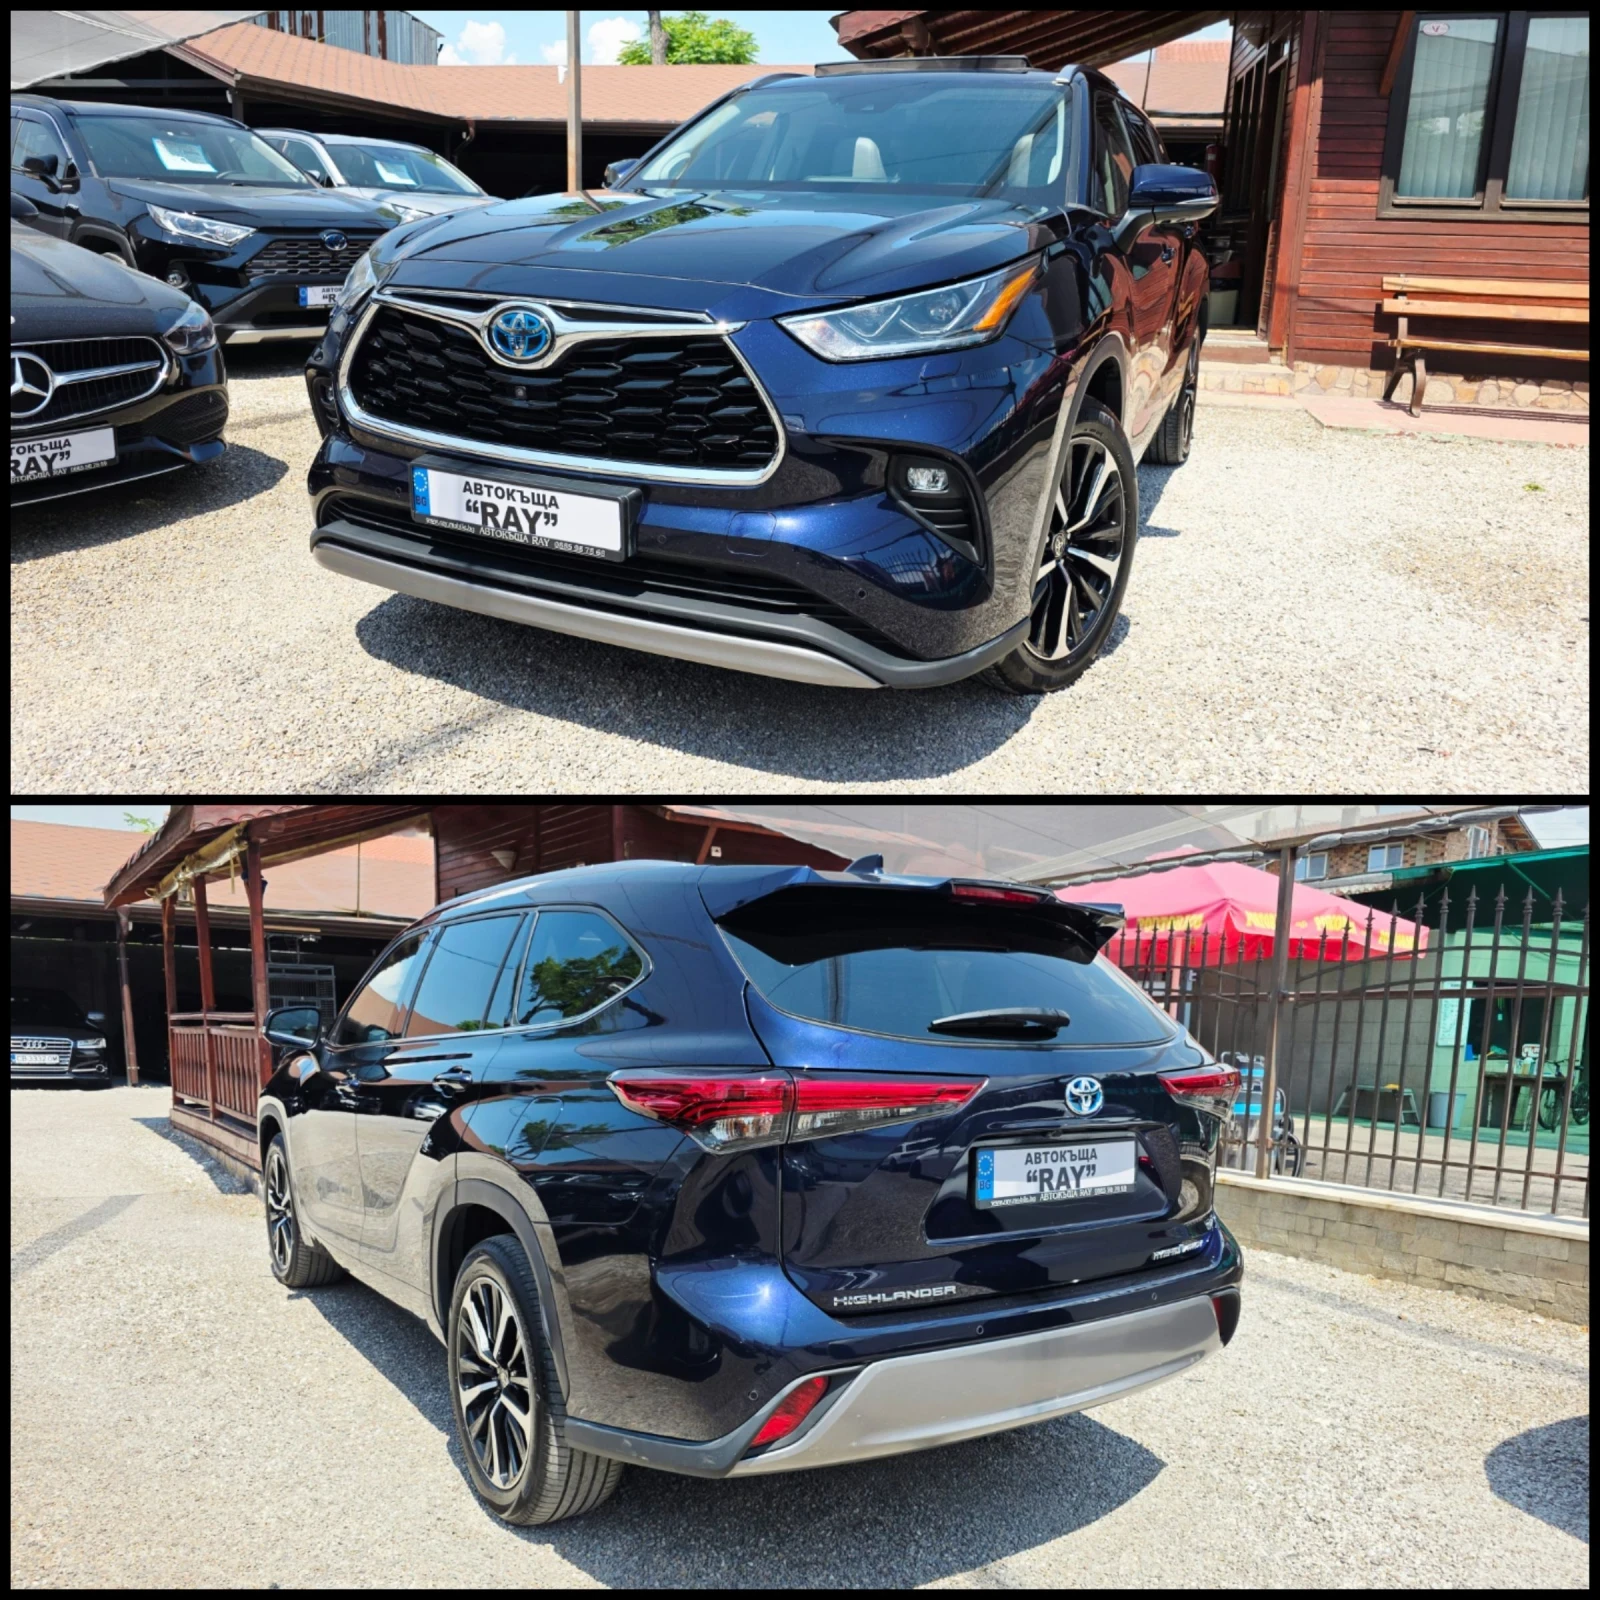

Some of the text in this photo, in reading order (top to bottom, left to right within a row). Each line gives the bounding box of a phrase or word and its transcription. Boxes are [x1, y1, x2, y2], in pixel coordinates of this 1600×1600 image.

[414, 495, 427, 506] BG
[462, 481, 560, 510] АВТОКЪЩА
[465, 499, 559, 535] “RAY”
[479, 526, 529, 544] АВТОКЪЩА
[531, 535, 550, 547] RAY
[1025, 1148, 1098, 1166] АВТОКЪЩА
[979, 1179, 991, 1190] BG
[1026, 1164, 1096, 1192] “RAY”
[833, 1285, 957, 1307] HIGHLANDER
